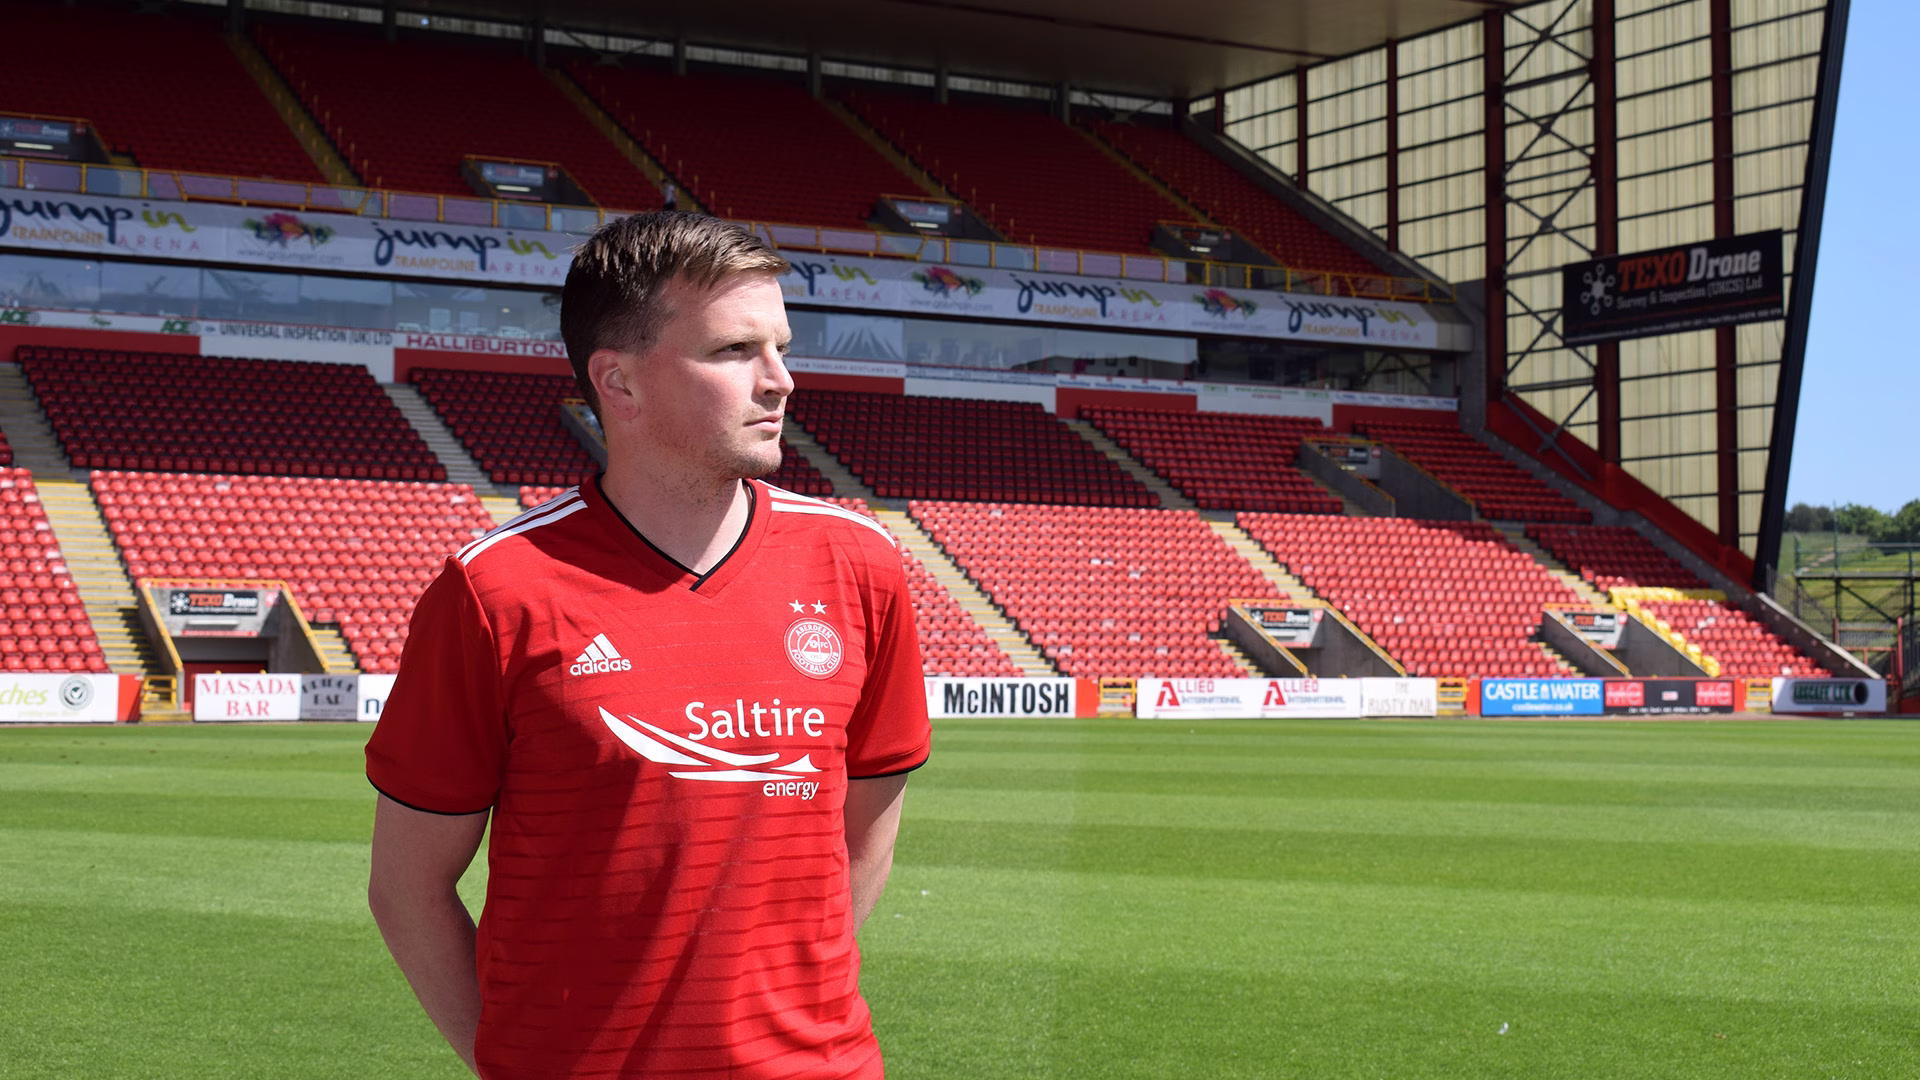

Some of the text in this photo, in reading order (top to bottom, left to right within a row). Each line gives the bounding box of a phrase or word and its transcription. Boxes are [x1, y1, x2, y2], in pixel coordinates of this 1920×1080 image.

[0, 198, 198, 244] jump in
[12, 226, 201, 250] TRAMPOLINE ARENA
[371, 222, 557, 271] jump in
[395, 256, 562, 277] TRAMPOLINE ARENA
[829, 258, 878, 286] in
[1618, 247, 1762, 293] TEXO Drone
[816, 287, 880, 302] ARENA
[1009, 273, 1163, 319] jump in
[1616, 294, 1648, 310] Survey
[1649, 291, 1658, 305] &
[1658, 286, 1706, 305] Inspection
[1746, 275, 1763, 292] Ltd
[1107, 308, 1166, 322] ARENA
[1278, 295, 1375, 337] jump
[1374, 302, 1418, 327] in
[220, 323, 281, 339] UNIVERSAL
[283, 326, 347, 343] INSPECTION
[373, 332, 393, 346] LTD
[406, 335, 564, 356] HALLIBURTON
[795, 624, 833, 638] ABERDEEN
[569, 657, 633, 677] adidas
[791, 650, 840, 672] FOOTBALL CLUB
[200, 679, 297, 696] MASADA
[944, 682, 1069, 714] McINTOSH
[1484, 682, 1539, 701] CASTLE
[1550, 682, 1601, 701] WATER
[226, 700, 270, 718] BAR
[1367, 697, 1406, 714] RUSTY
[685, 697, 825, 741] Saltire
[763, 781, 820, 801] energy
